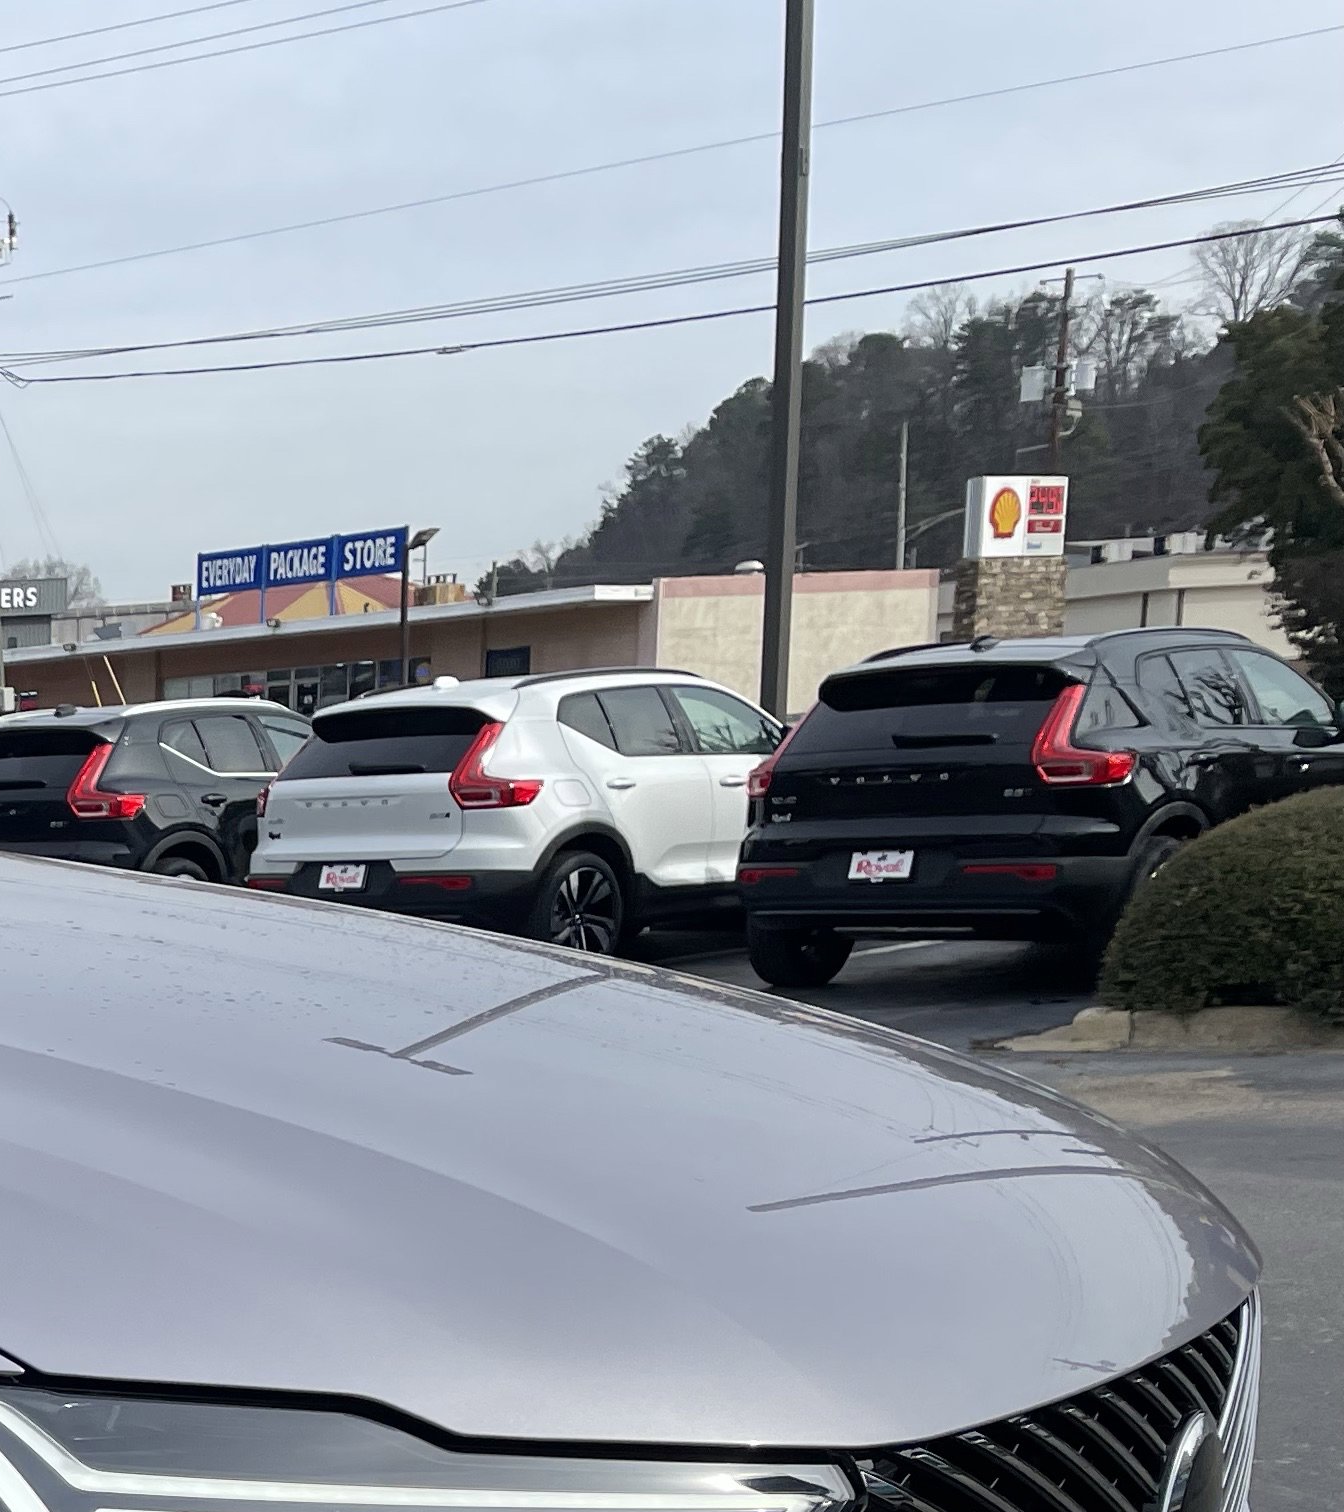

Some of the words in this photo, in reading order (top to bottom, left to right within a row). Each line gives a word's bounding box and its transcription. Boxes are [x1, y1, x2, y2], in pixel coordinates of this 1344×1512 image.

[201, 554, 257, 588] EVERYDAY
[269, 545, 326, 581] PACKAGE
[343, 536, 396, 571] STORE
